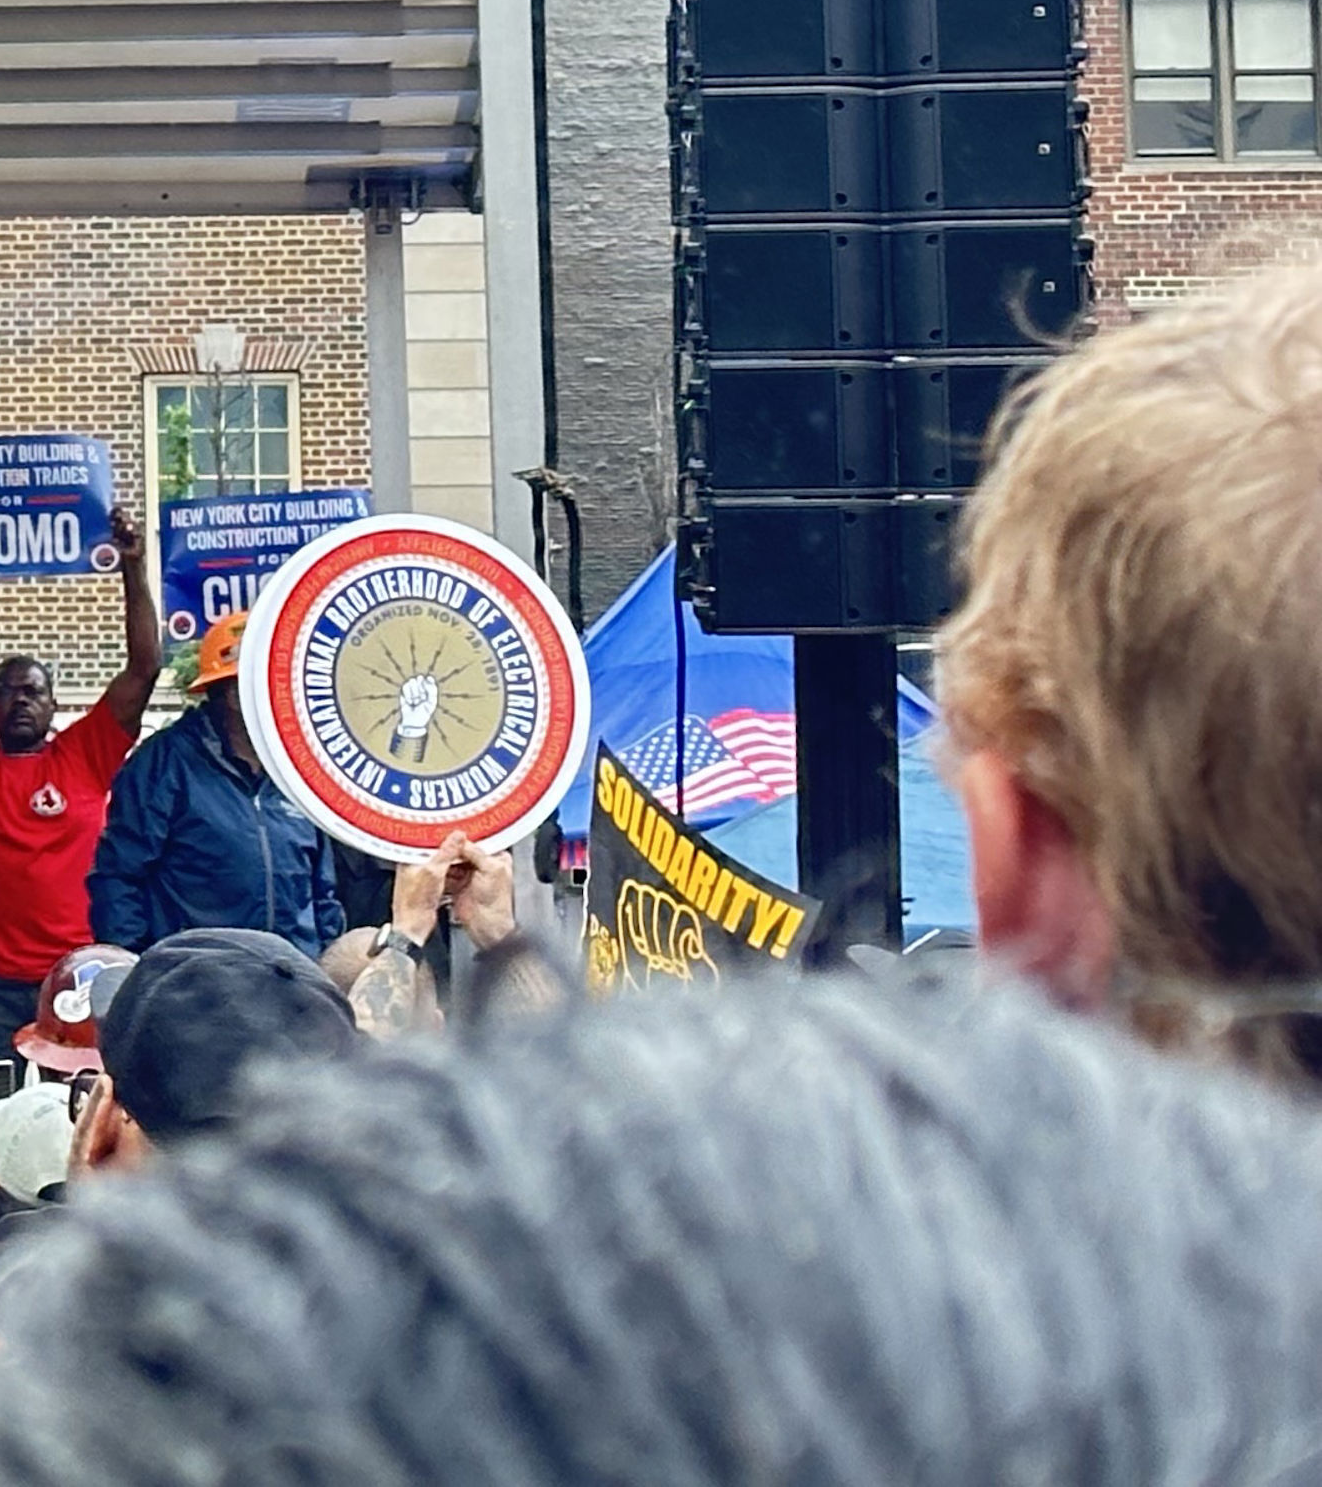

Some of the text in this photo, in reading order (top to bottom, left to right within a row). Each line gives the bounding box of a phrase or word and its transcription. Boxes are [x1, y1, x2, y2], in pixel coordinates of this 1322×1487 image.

[18, 443, 84, 464] BUILDING
[87, 444, 99, 463] &
[34, 466, 89, 486] TRADES
[170, 507, 204, 528] NEW
[206, 504, 246, 525] YORK
[250, 501, 283, 523] CITY
[285, 497, 354, 521] BUILDING
[187, 526, 298, 551] CONSTRUCTION
[325, 569, 467, 632] BROTHERHOOD
[467, 597, 502, 629] OF
[350, 605, 424, 647] ORGANIZED
[305, 631, 387, 794] INTERNATIONAL
[491, 628, 535, 757] ELECTRICAL
[409, 754, 508, 809] WORKERS
[598, 757, 804, 959] SOLIDARITY!
